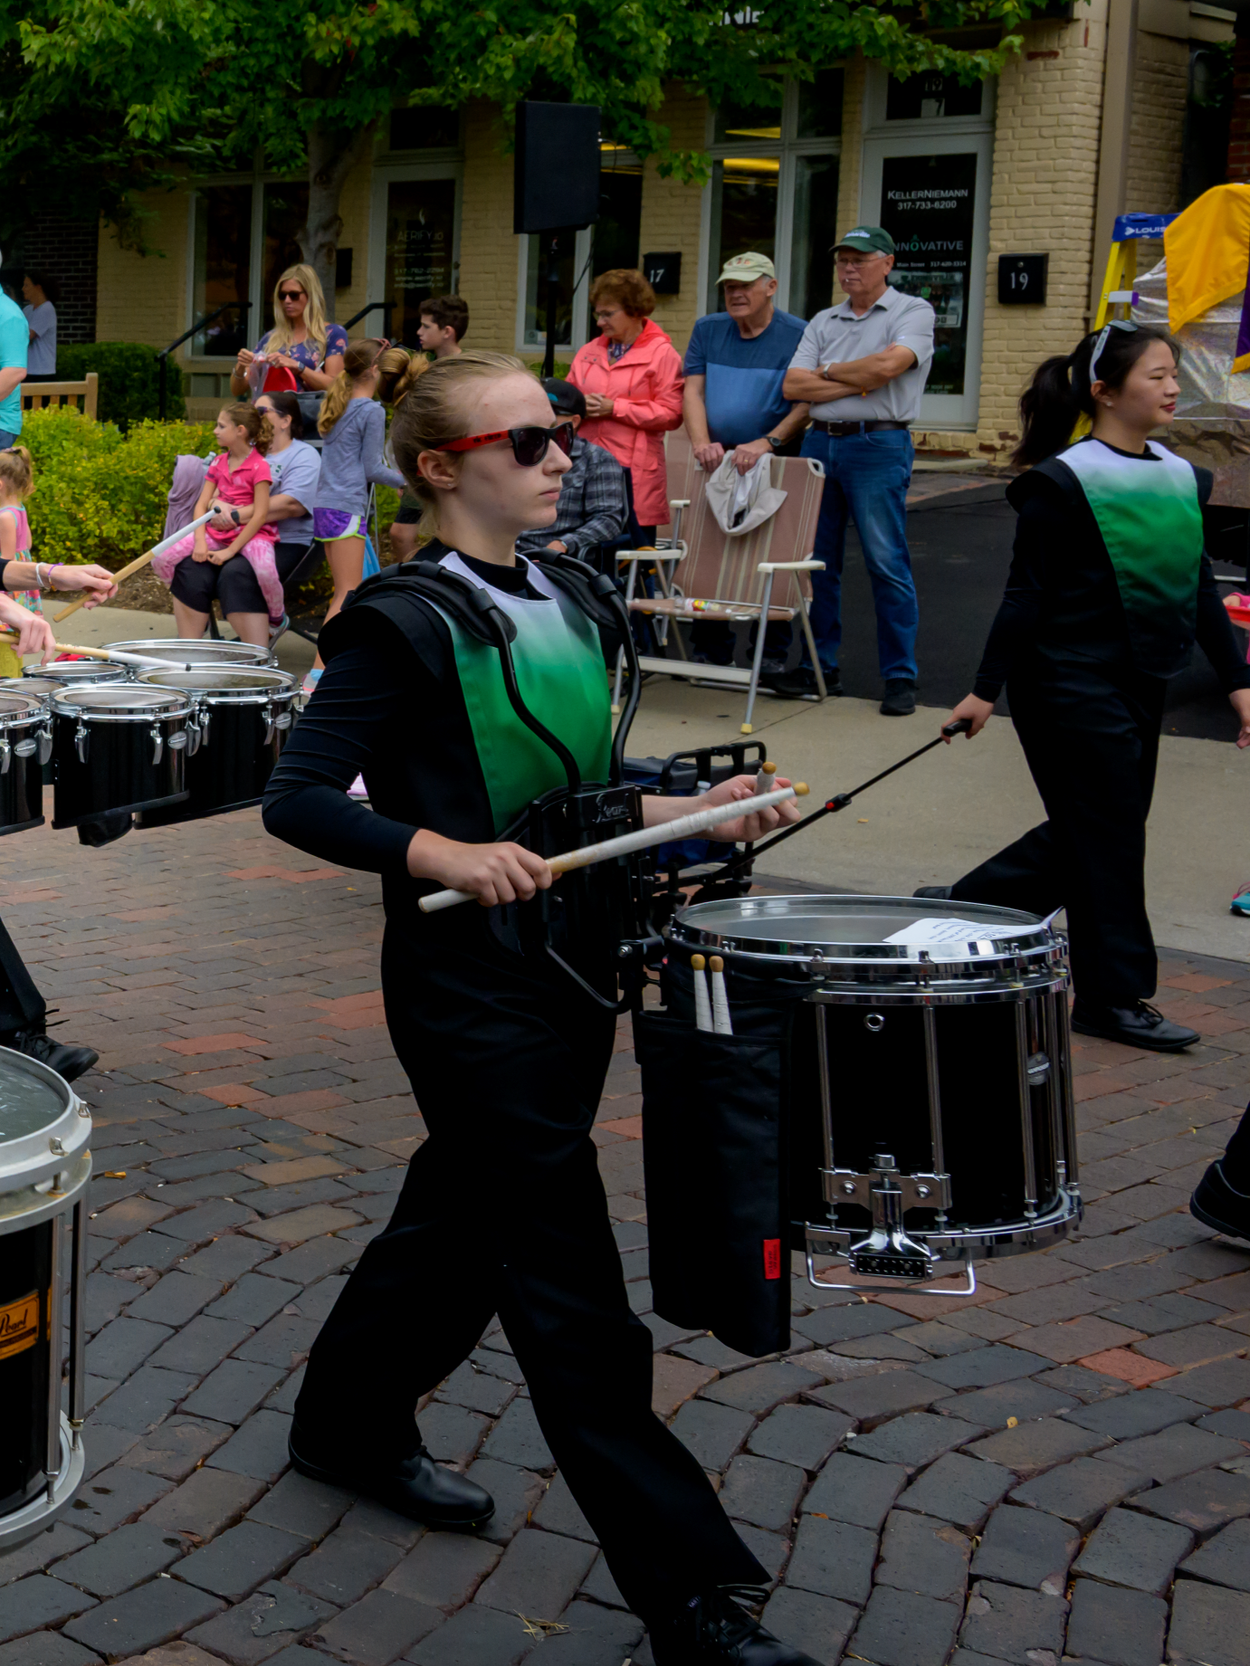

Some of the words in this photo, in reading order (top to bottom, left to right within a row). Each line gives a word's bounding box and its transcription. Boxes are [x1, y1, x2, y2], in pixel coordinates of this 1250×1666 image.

[897, 200, 957, 210] 317-733-6200
[1135, 226, 1167, 234] LOUIS
[895, 240, 964, 251] NNOVATIVE
[650, 268, 665, 283] 17
[1011, 272, 1029, 290] 19
